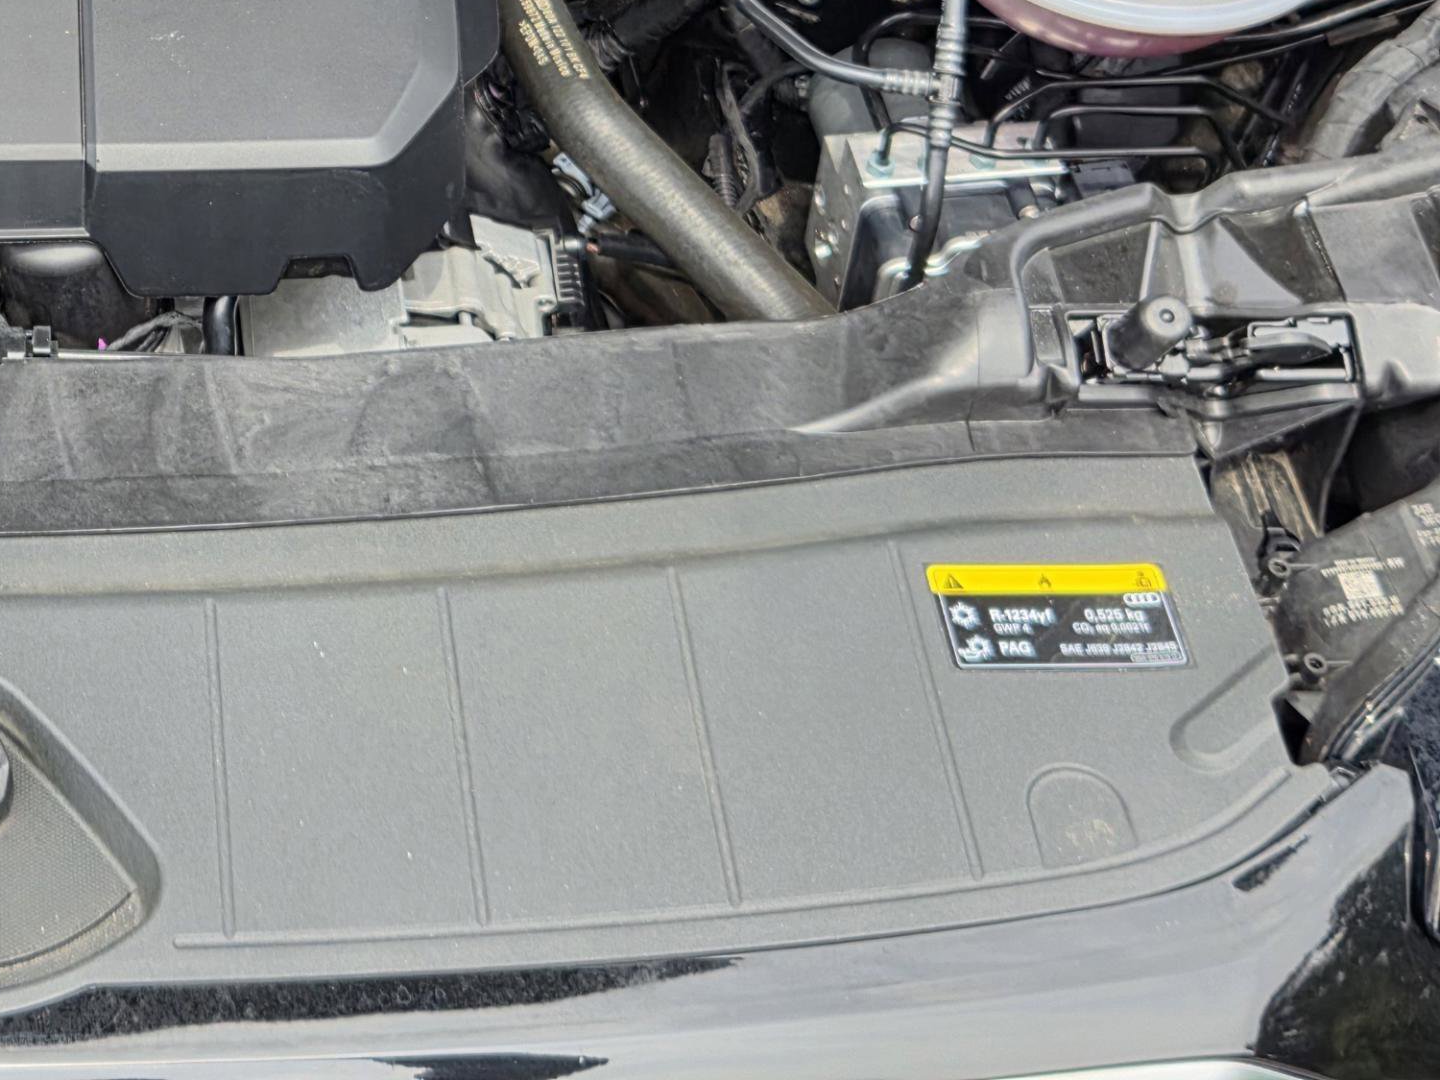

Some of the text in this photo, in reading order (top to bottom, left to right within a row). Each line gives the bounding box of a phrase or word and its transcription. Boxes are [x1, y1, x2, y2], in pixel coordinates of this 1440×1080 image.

[989, 608, 1056, 626] R-1234yf
[1125, 607, 1148, 622] kg
[993, 623, 1022, 635] GWP
[999, 640, 1037, 657] PAG
[1060, 642, 1084, 656] SAE
